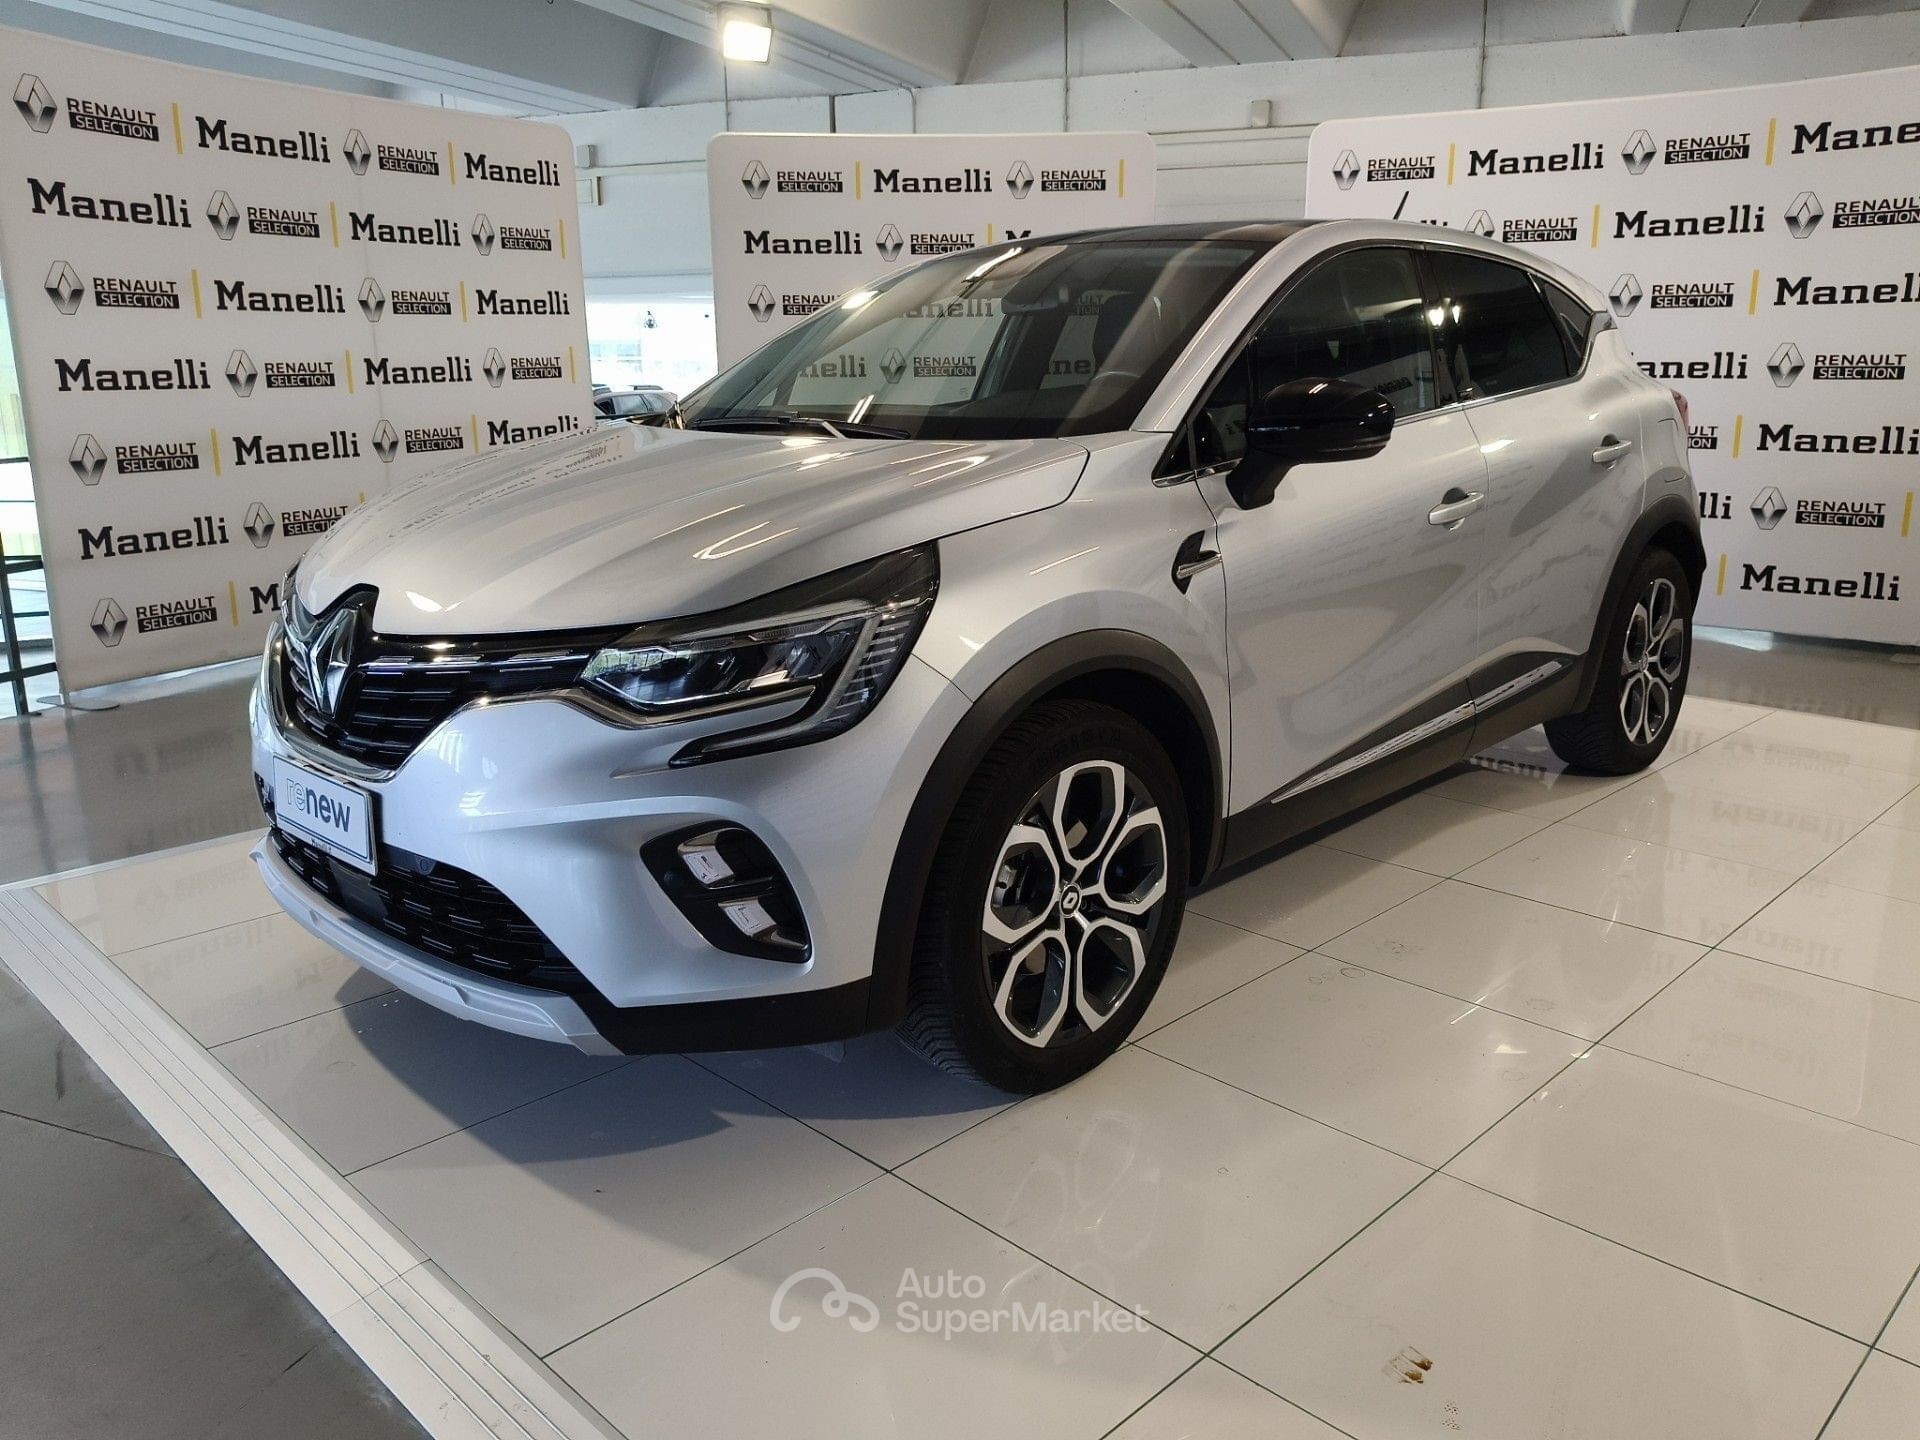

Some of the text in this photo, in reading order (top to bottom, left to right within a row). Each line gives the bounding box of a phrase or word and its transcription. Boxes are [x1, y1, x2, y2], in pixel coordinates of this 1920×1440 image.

[67, 97, 156, 125] RENAULT
[75, 116, 154, 139] SELECTION
[195, 115, 330, 163] Manelli
[1666, 133, 1751, 150] RENAULT
[1791, 121, 1920, 154] Mane
[378, 144, 437, 161] RENAULT
[1468, 143, 1603, 176] Manelli
[1670, 148, 1743, 163] SELECTION
[383, 159, 435, 174] SELECTION
[464, 152, 560, 186] Manelli
[1368, 156, 1435, 168] RENAULT
[778, 170, 842, 182] RENAULT
[874, 168, 992, 193] Manelli
[1041, 169, 1106, 181] RENAULT
[1371, 168, 1431, 180] SELECTION
[782, 182, 838, 192] SELECTION
[1046, 180, 1102, 190] SELECTION
[27, 178, 191, 228] Manelli
[1834, 197, 1920, 213] RENAUL
[247, 207, 318, 223] RENAULT
[1613, 205, 1765, 238] Manelli
[254, 221, 315, 236] SELECTION
[349, 212, 461, 246] Manelli
[1503, 217, 1578, 230] RENAULT
[500, 227, 550, 238] RENAULT
[910, 234, 975, 243] RENAULT
[1506, 230, 1572, 242] SELECTION
[505, 238, 549, 250] SELECTION
[744, 230, 862, 255] Manelli
[93, 277, 177, 293] RENAULT
[1652, 282, 1735, 296] RENAULT
[1773, 272, 1920, 306] Manel
[101, 293, 174, 308] SELECTION
[214, 280, 345, 313] Manelli
[392, 291, 450, 302] RENAULT
[476, 289, 570, 315] Manelli
[1656, 295, 1728, 307] SELECTION
[397, 303, 448, 314] SELECTION
[265, 362, 333, 374] RENAULT
[511, 357, 561, 367] RENAULT
[914, 356, 976, 366] RENAULT
[1636, 352, 1748, 379] anelli
[1814, 354, 1907, 367] RENAULT
[55, 358, 210, 391] Manelli
[364, 357, 472, 385] Manelli
[515, 367, 559, 378] SELECTION
[918, 367, 973, 376] SELECTION
[1819, 367, 1898, 379] SELECTION
[271, 375, 331, 387] SELECTION
[405, 426, 462, 440] RENAULT
[1756, 424, 1919, 455] Manelli
[115, 442, 196, 459] RENAULT
[232, 431, 360, 466] Manelli
[410, 438, 459, 451] SELECTION
[123, 458, 194, 472] SELECTION
[281, 506, 348, 522] RENAULT
[1797, 500, 1886, 515] RENAULT
[1801, 512, 1878, 527] SELECTION
[288, 520, 337, 535] SELECTI
[78, 516, 229, 560] Manelli
[1740, 563, 1900, 601] Manelli
[136, 596, 215, 617] RENAULT
[143, 610, 212, 630] SELECTION
